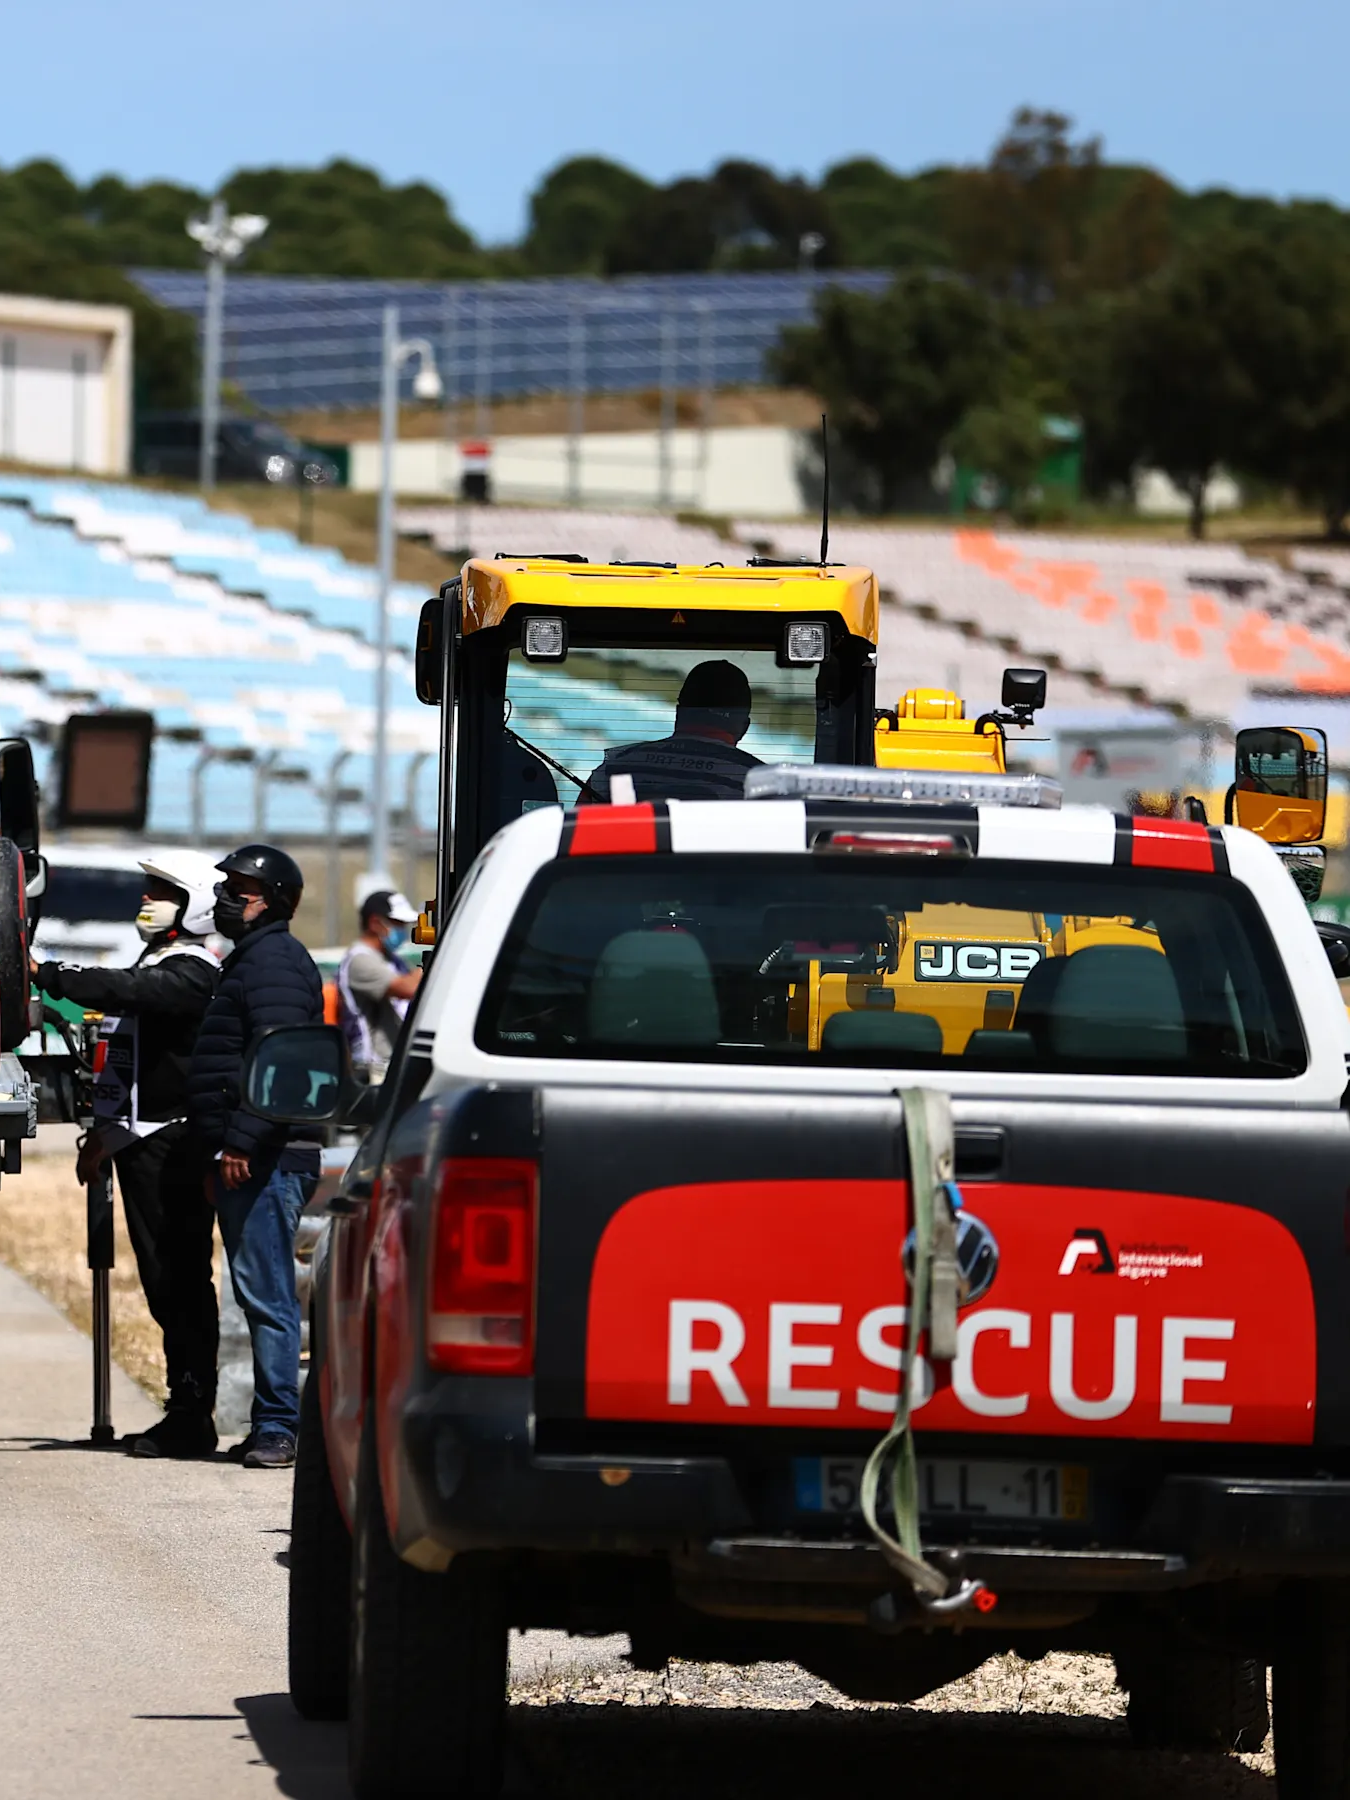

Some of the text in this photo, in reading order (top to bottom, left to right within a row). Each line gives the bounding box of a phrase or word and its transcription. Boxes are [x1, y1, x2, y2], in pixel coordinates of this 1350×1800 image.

[920, 945, 1041, 978] JCB
[1118, 1252, 1203, 1267] internacional
[1118, 1265, 1168, 1280] algarve
[668, 1299, 1236, 1425] RESCUE
